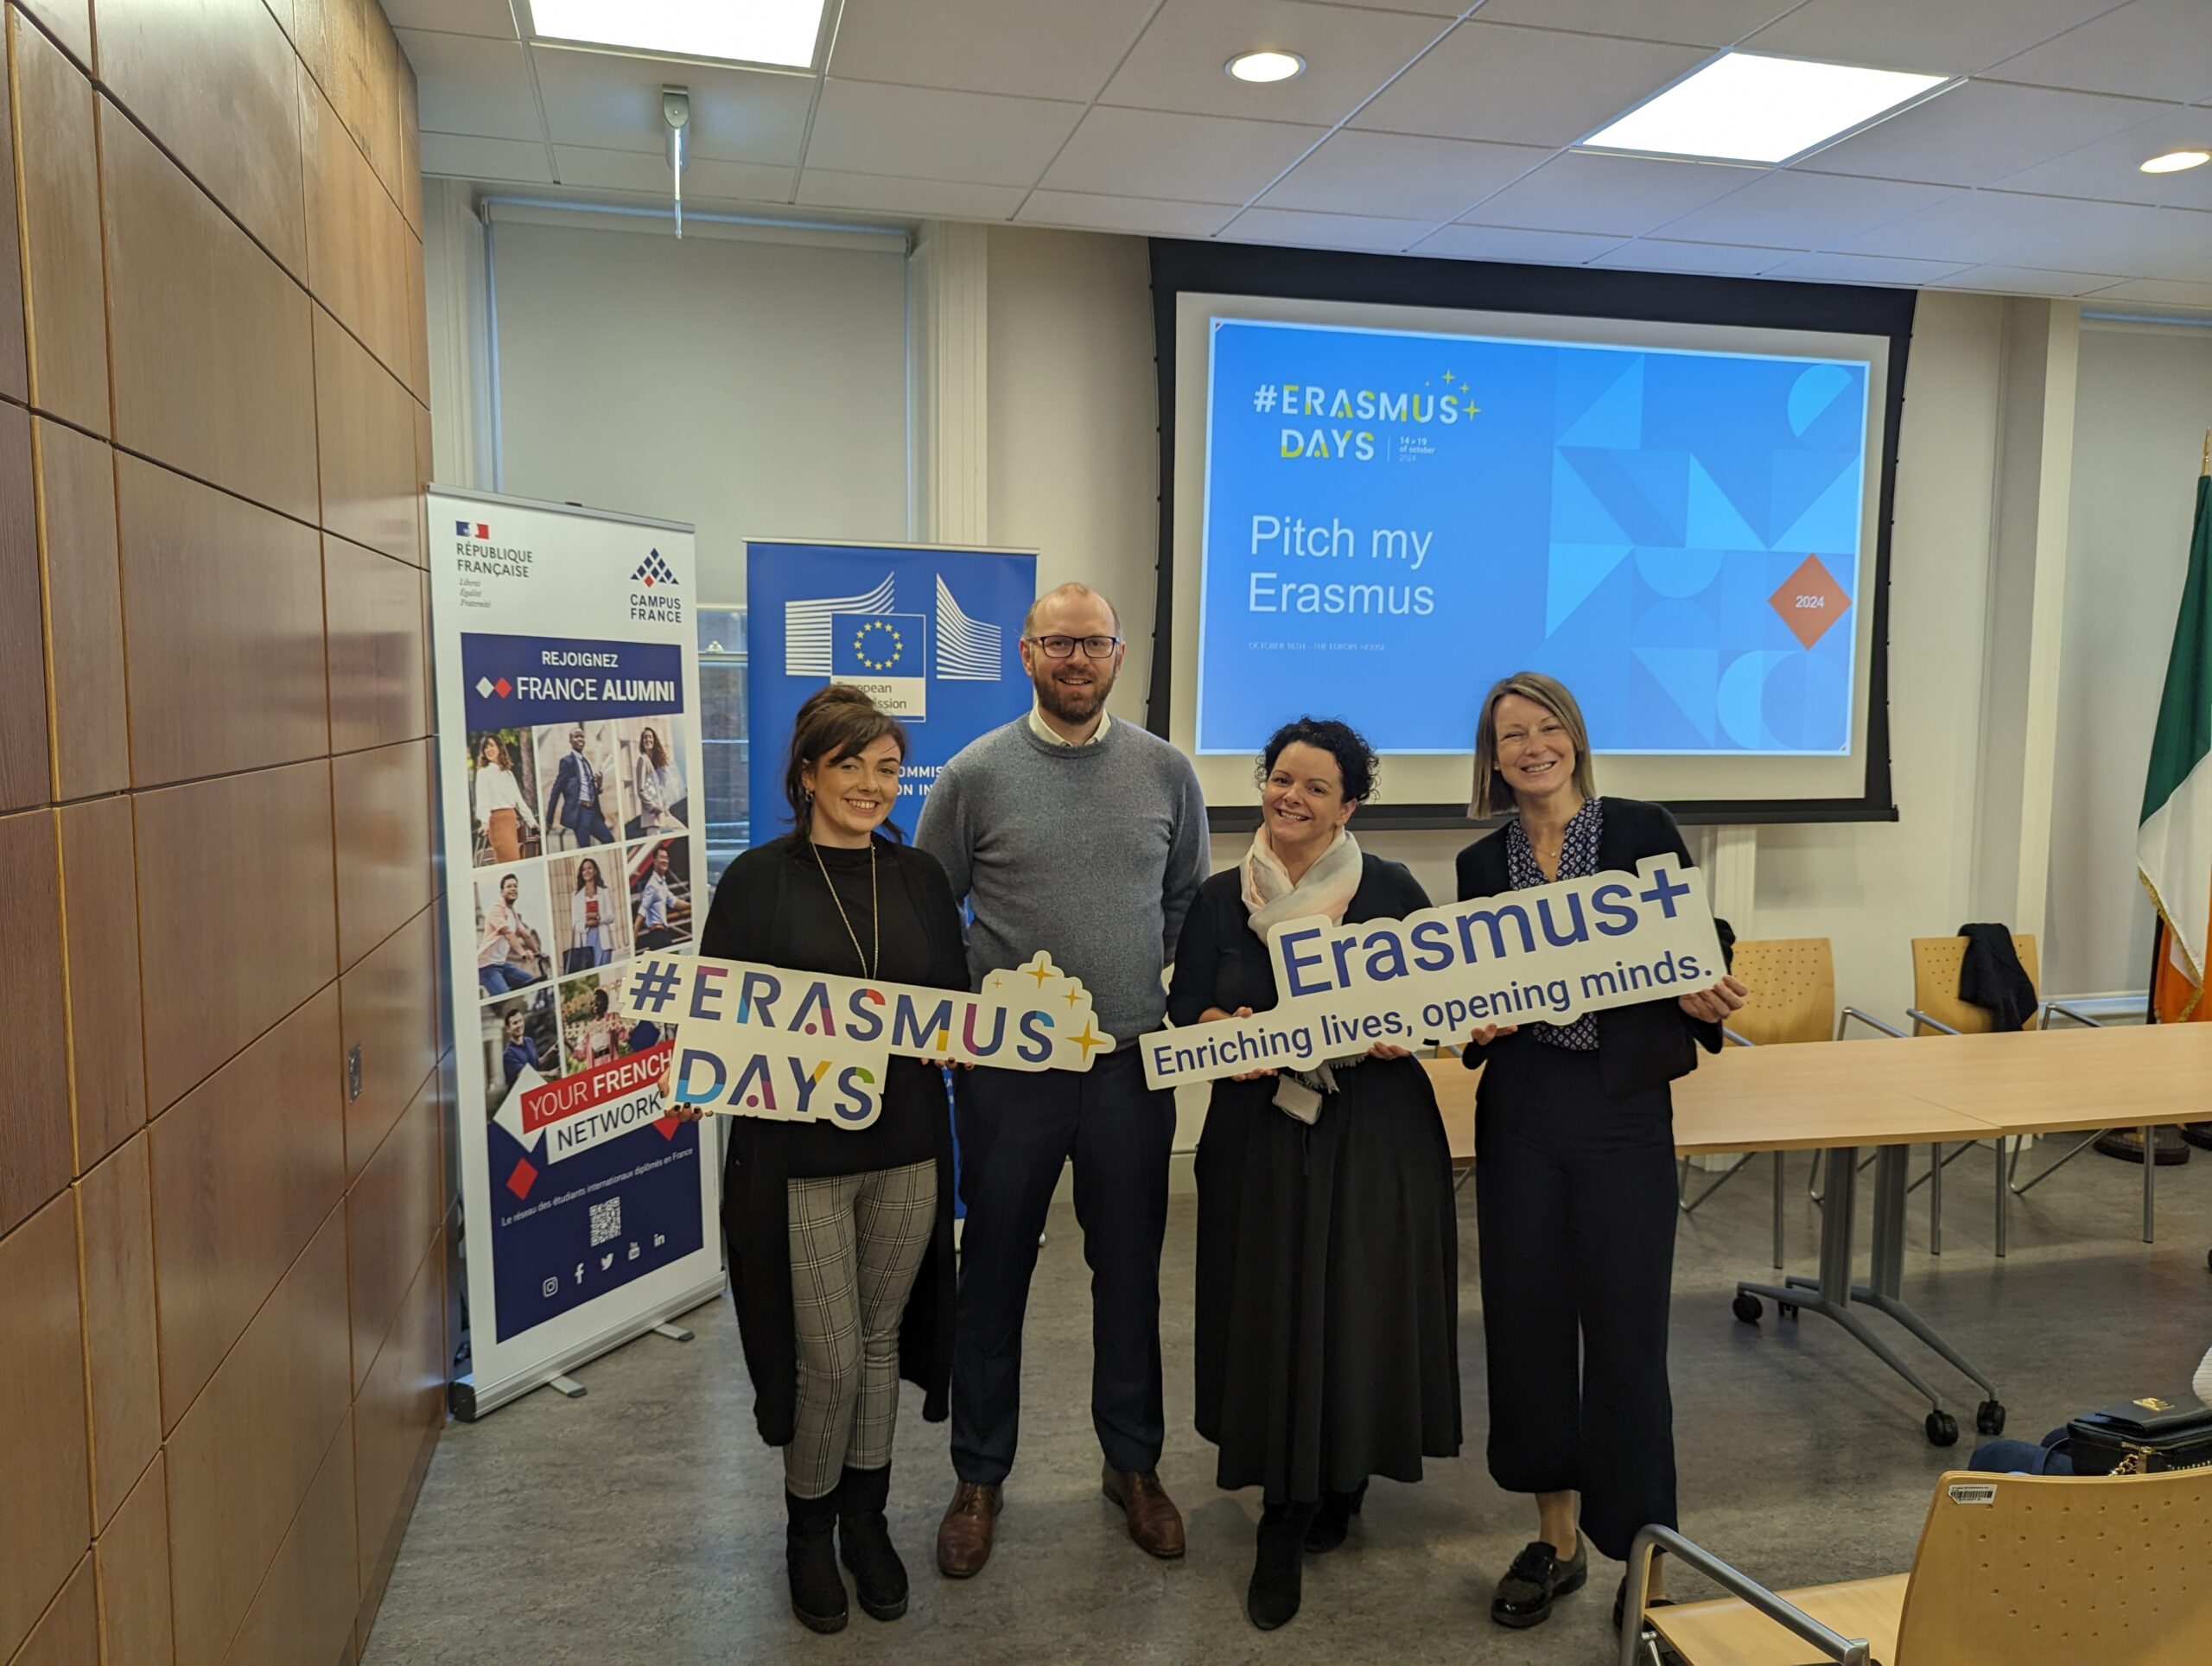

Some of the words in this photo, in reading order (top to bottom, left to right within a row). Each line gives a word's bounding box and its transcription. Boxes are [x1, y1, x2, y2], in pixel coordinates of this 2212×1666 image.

[1254, 385, 1459, 424] #ERASMUS
[1281, 429, 1374, 461] DAYS
[1400, 436, 1409, 445] 14
[456, 541, 533, 563] RÉPUBLIQUE
[1251, 515, 1354, 557] Pitch
[1372, 528, 1433, 570] my
[457, 559, 530, 577] FRANÇAISE
[630, 594, 682, 610] CAMPUS
[1249, 572, 1434, 616] Erasmus
[1796, 595, 1825, 608] 2024
[630, 607, 683, 623] FRANCE
[542, 651, 618, 668] REJOIGNEZ
[517, 677, 598, 701] FRANCE
[602, 679, 675, 702] ALUMNI
[1280, 868, 1691, 997] Erasmus+
[629, 960, 1055, 1063] #ERASMUS
[1154, 1029, 1313, 1077] Enriching
[1320, 1008, 1414, 1046] lives,
[1422, 978, 1571, 1032] opening
[1580, 950, 1713, 999] minds.
[528, 1082, 588, 1120] YOUR
[593, 1049, 672, 1097] FRENCH
[675, 1049, 875, 1121] DAYS
[557, 1091, 662, 1151] NETWORK
[501, 1217, 512, 1227] Le
[537, 1200, 552, 1211] des
[664, 1155, 672, 1165] en
[672, 1148, 693, 1160] France
